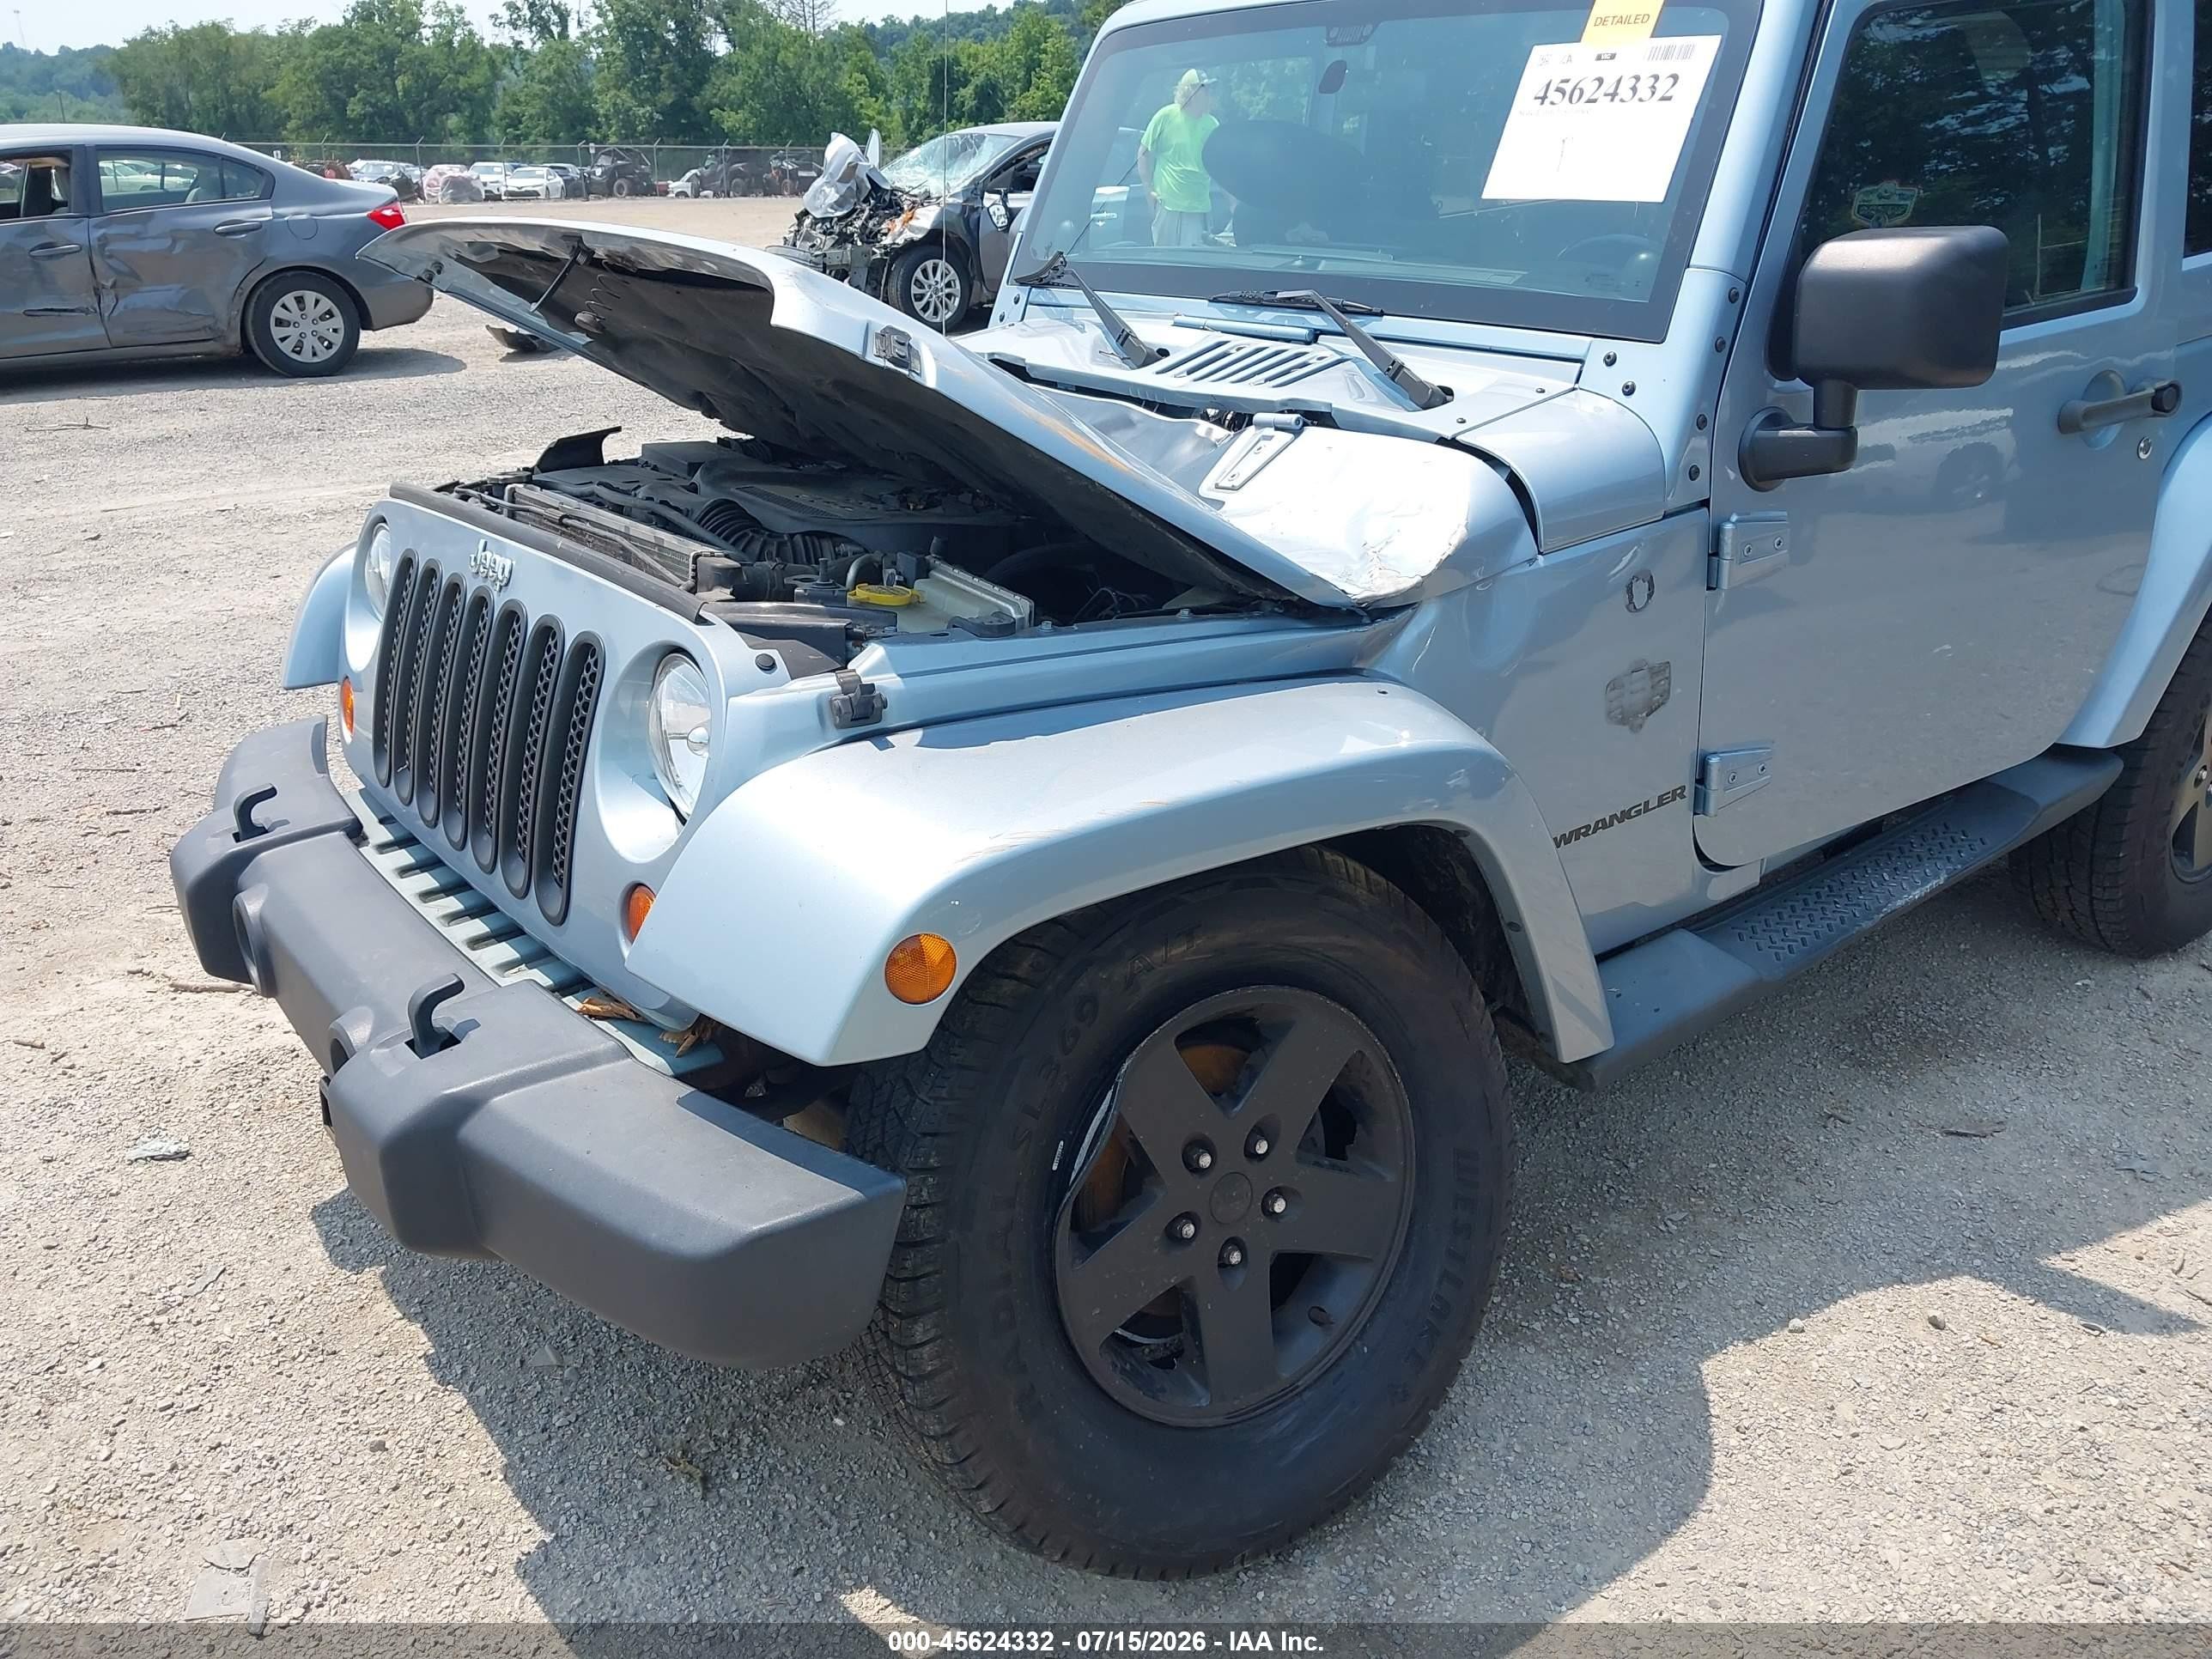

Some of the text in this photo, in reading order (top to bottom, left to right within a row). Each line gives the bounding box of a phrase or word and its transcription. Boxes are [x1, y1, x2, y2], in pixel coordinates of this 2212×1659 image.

[1594, 14, 1650, 27] DETAILED
[1534, 73, 1680, 106] 45624332
[470, 539, 514, 591] Jeep
[1553, 785, 1687, 848] WRANGLER
